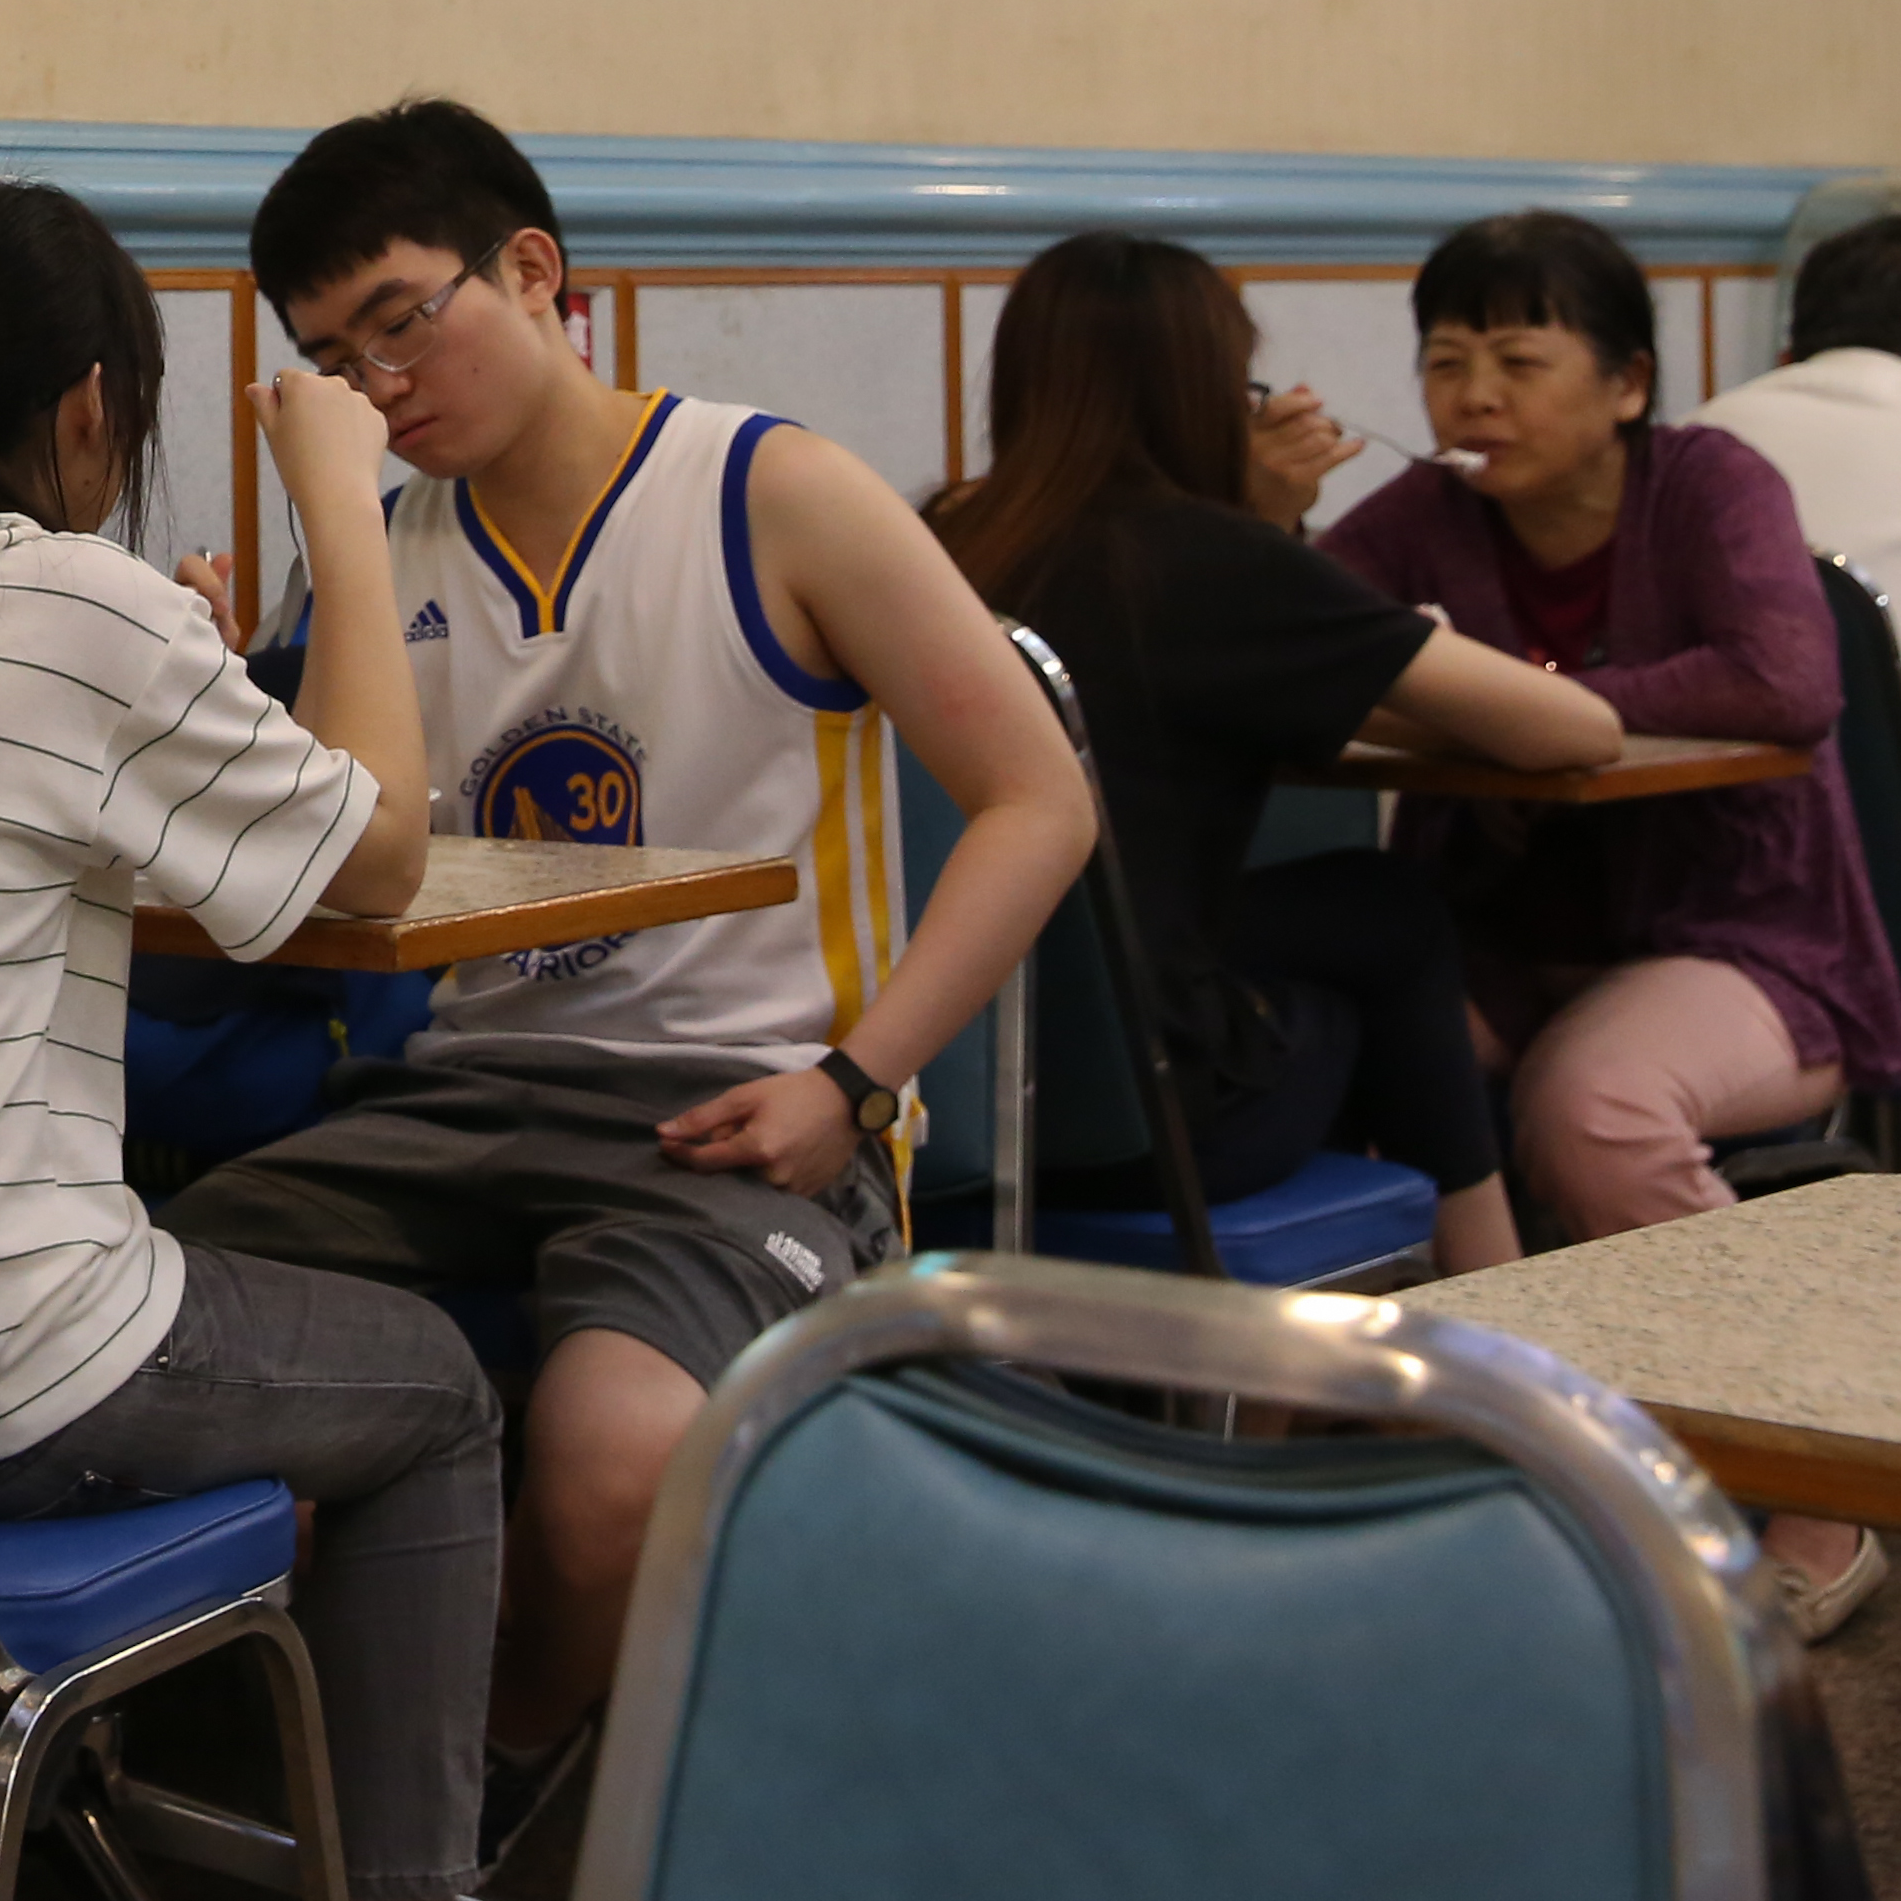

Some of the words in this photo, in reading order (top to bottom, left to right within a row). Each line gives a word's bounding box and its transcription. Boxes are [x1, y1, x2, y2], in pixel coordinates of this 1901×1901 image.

[460, 705, 568, 797] GOLDEN
[578, 706, 646, 760] STATE
[566, 770, 627, 831] 30
